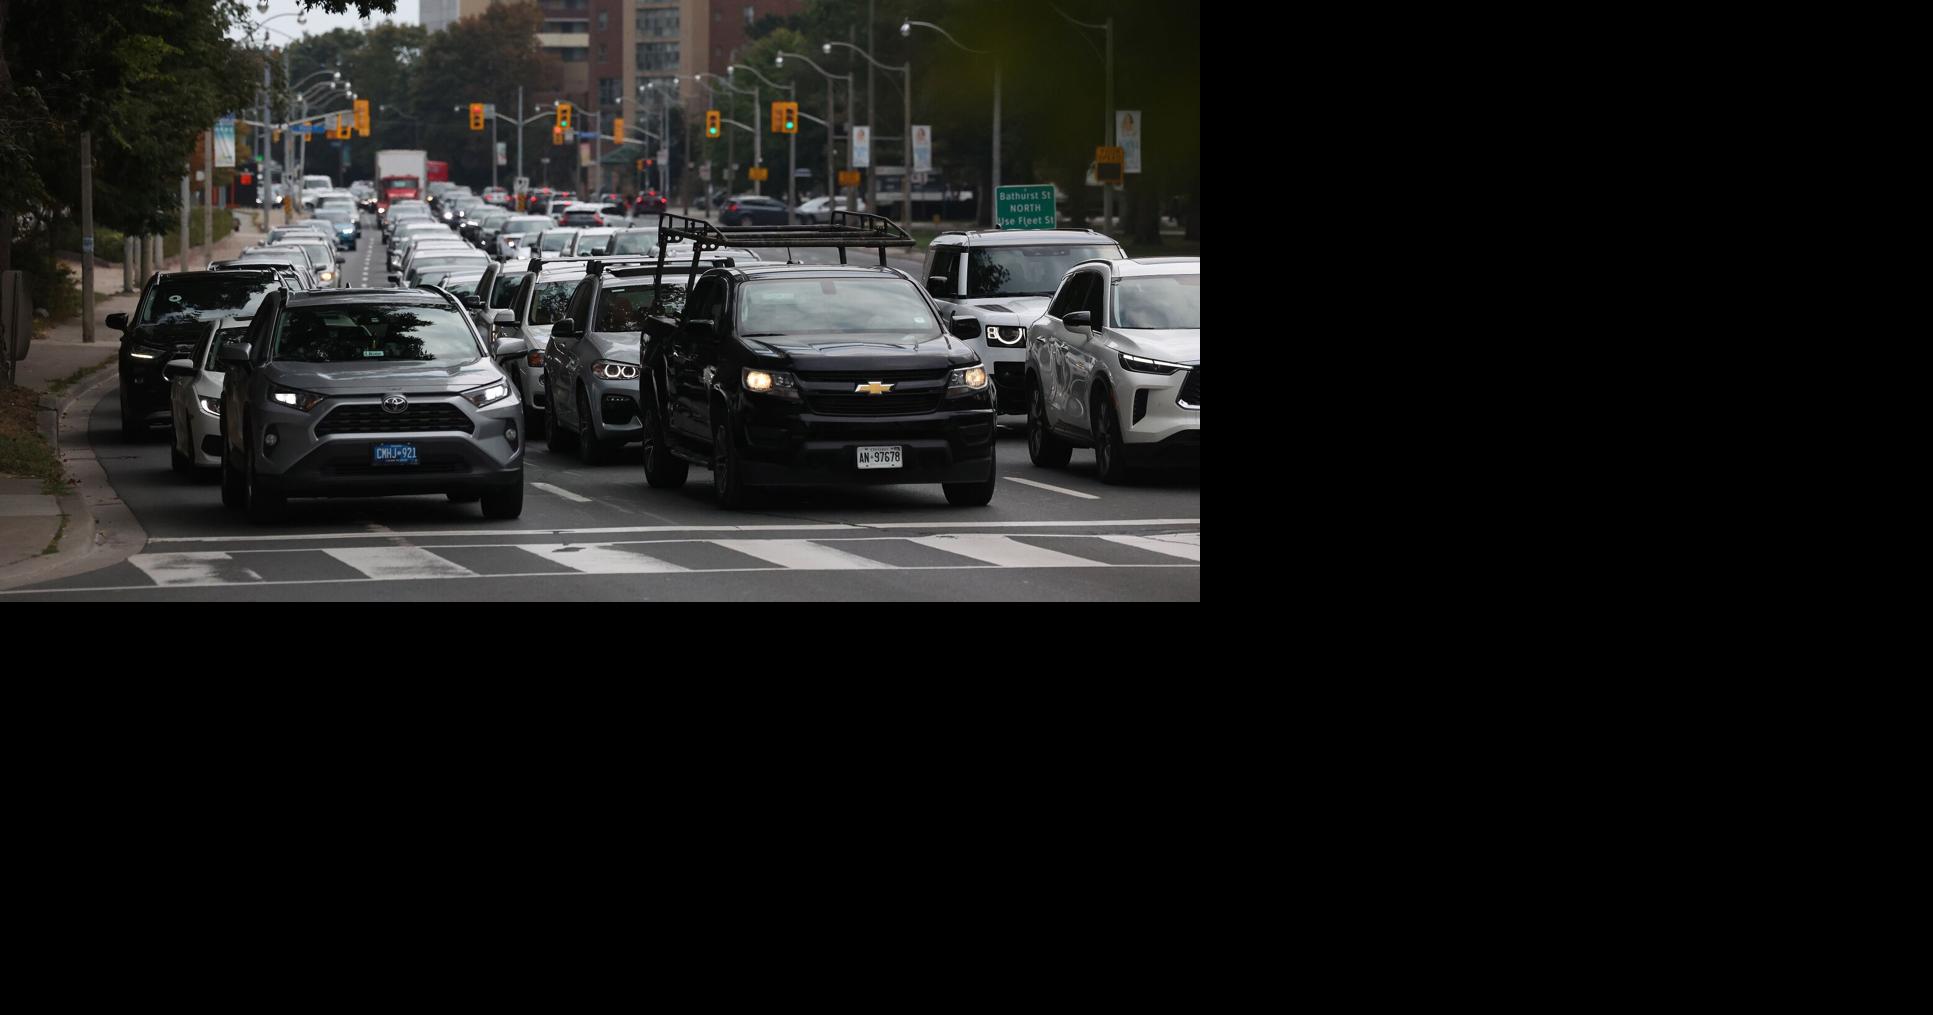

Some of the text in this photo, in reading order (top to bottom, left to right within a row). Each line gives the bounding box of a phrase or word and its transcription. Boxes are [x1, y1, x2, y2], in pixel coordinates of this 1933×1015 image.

[999, 190, 1051, 201] Bathurst St
[1010, 203, 1041, 213] NORTH
[998, 215, 1054, 226] Use Fleet St
